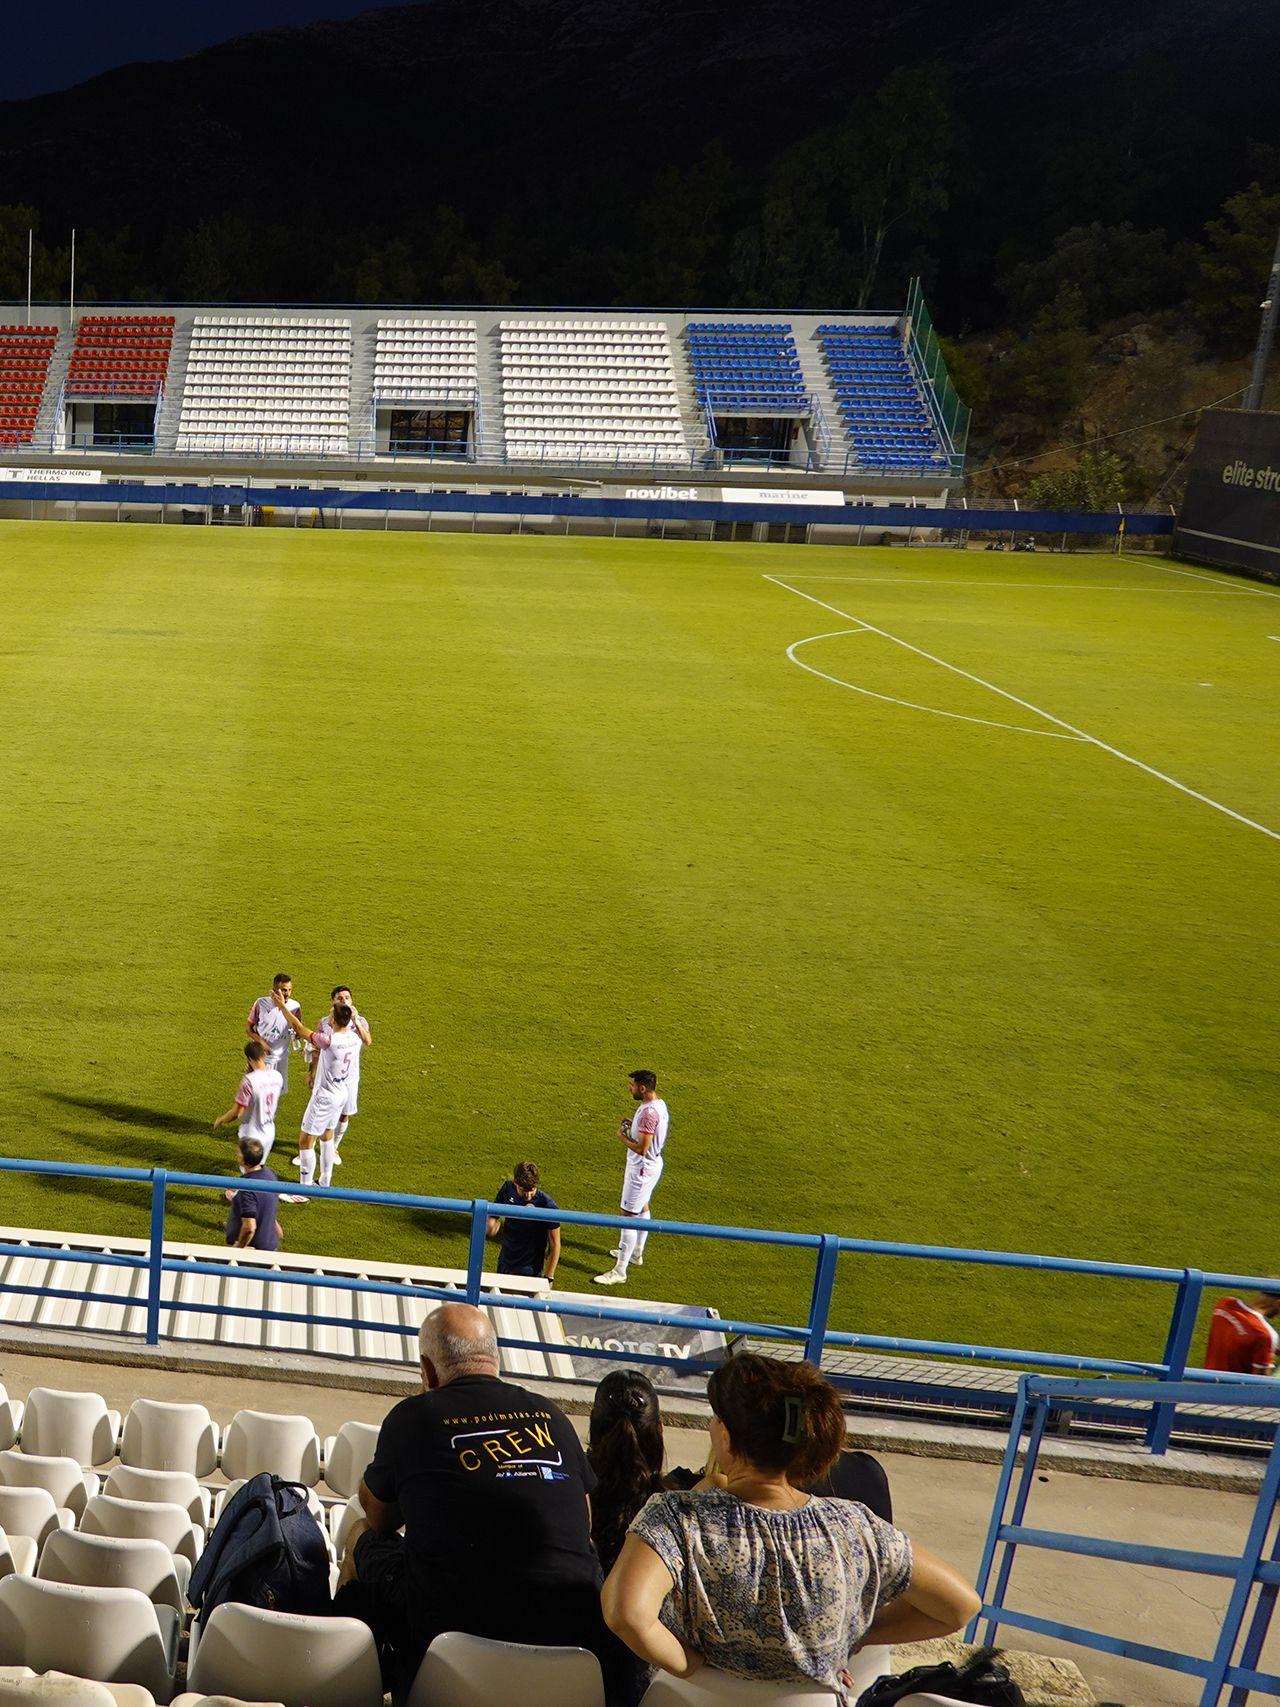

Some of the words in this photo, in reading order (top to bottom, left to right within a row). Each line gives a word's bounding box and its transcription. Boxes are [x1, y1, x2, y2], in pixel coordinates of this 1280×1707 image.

[1222, 460, 1254, 487] elite
[625, 487, 698, 499] novibet
[759, 490, 808, 499] marine
[460, 1422, 555, 1471] CREW
